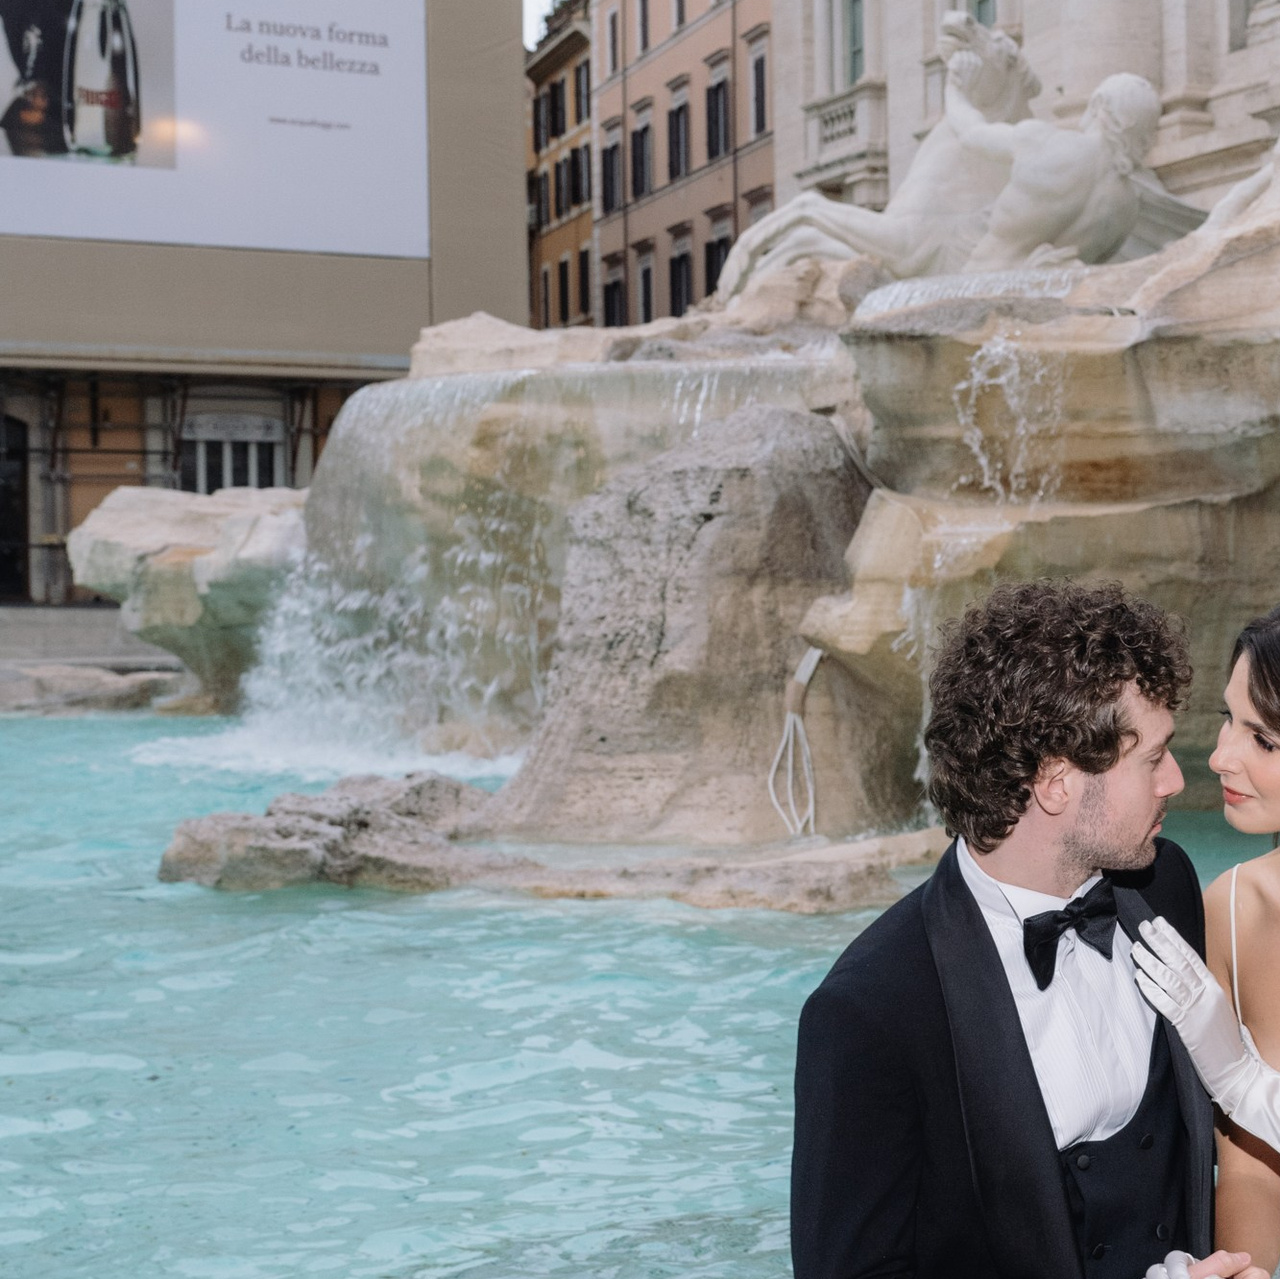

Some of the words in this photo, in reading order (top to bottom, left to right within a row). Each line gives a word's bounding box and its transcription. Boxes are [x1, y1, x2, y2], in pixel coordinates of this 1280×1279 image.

[225, 12, 252, 33] La
[258, 20, 322, 41] nuova
[327, 22, 390, 48] forma
[240, 43, 292, 67] della
[296, 48, 380, 76] bellezza
